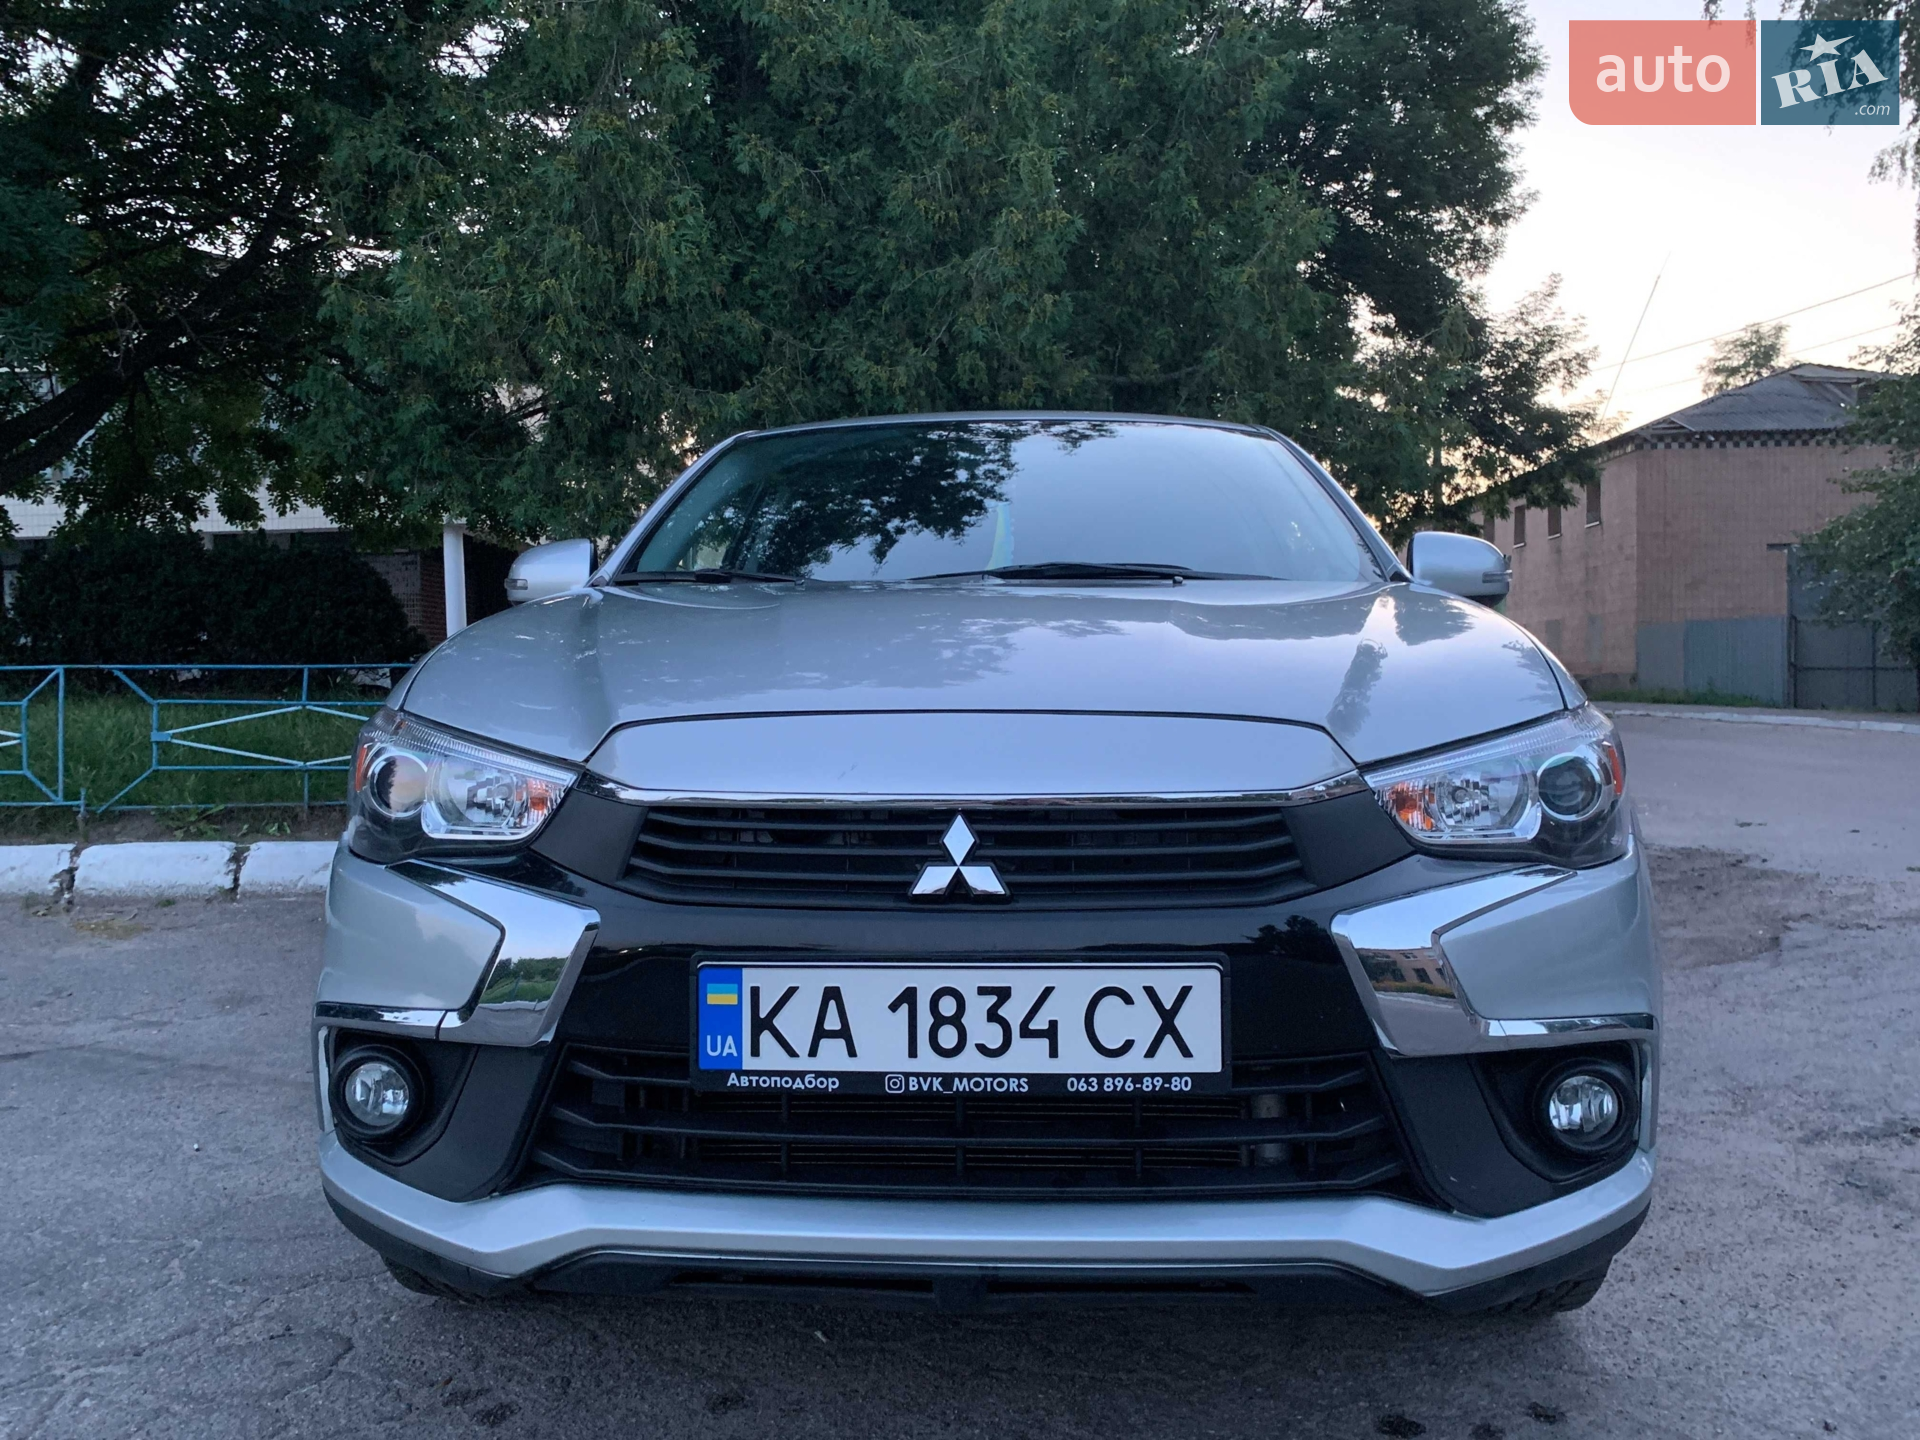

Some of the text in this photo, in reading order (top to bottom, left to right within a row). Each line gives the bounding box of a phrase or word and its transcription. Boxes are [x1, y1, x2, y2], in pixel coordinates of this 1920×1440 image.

[749, 985, 1194, 1059] KA 1834 CX
[706, 1035, 738, 1057] UA
[726, 1072, 840, 1092] Автоподбор
[908, 1076, 1029, 1094] BVK_MOTORS
[1066, 1076, 1192, 1092] 063 896-89-80
